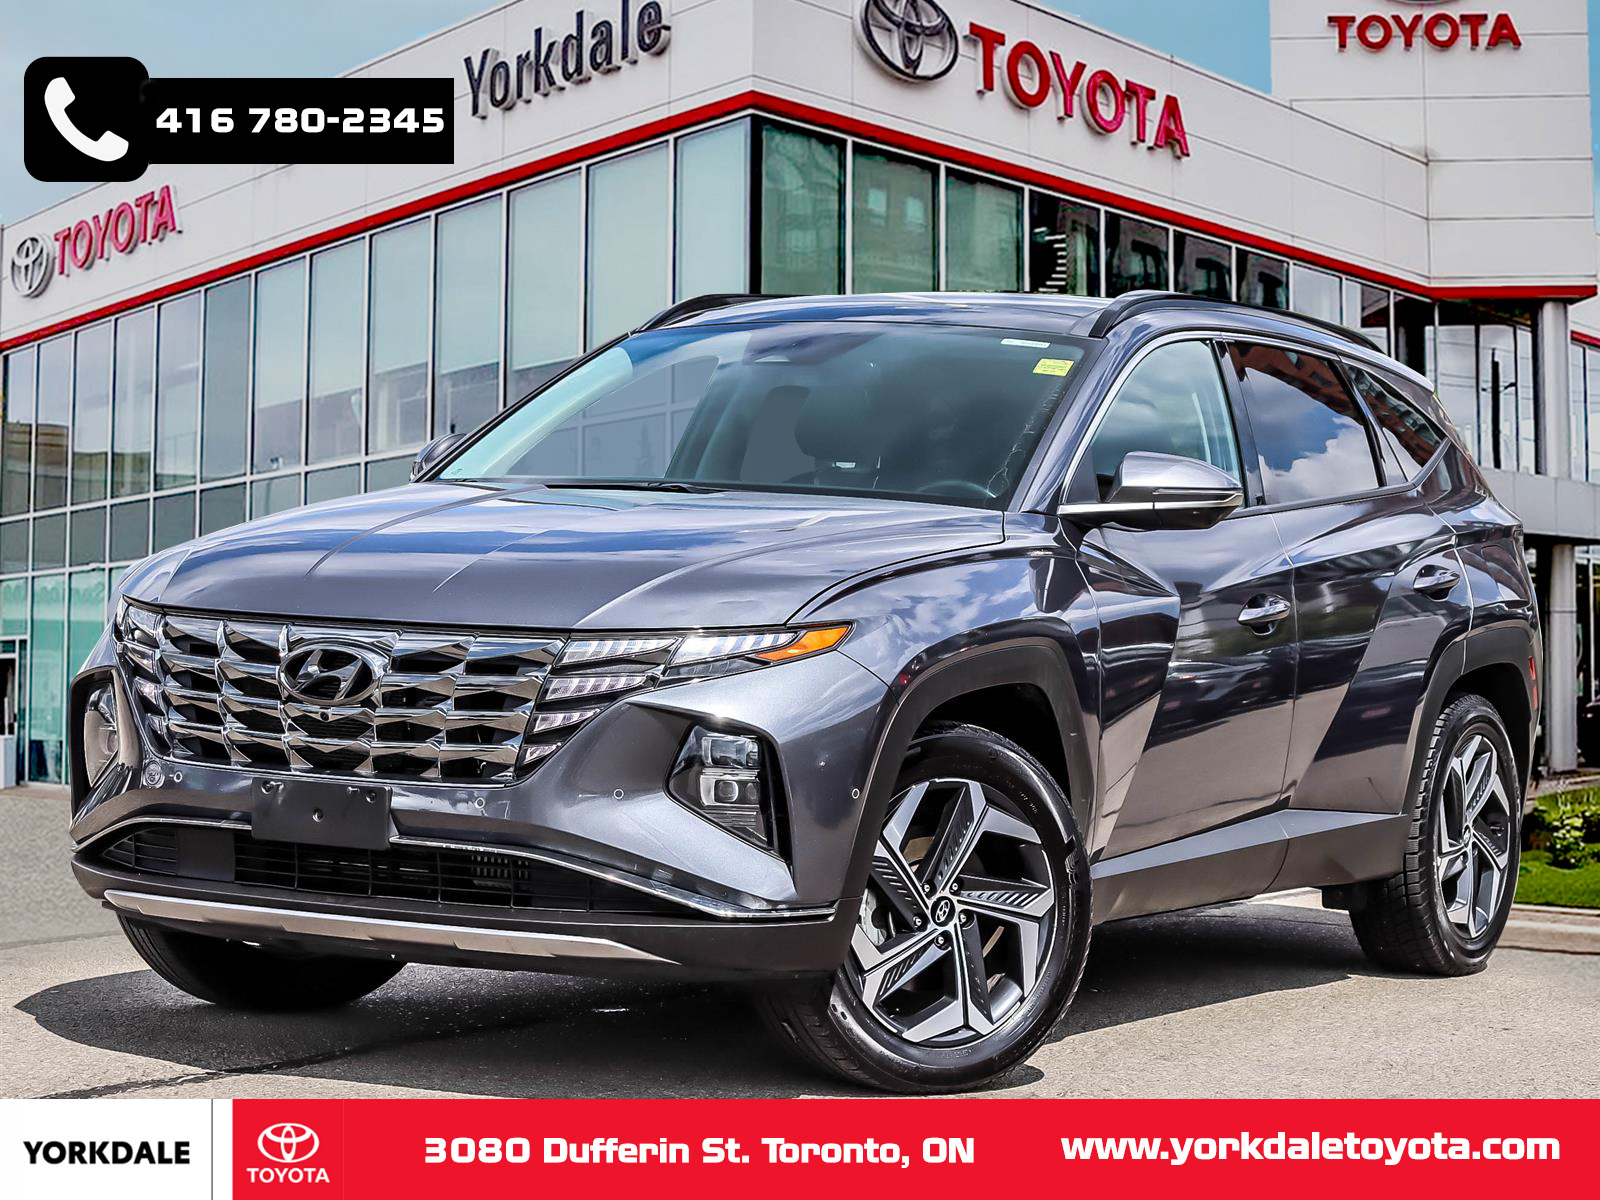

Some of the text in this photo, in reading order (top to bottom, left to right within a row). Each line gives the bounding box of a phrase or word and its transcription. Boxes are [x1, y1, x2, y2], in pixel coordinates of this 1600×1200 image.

[463, 0, 671, 119] Yorkdale
[1327, 13, 1522, 50] TOYOTA
[966, 21, 1191, 158] TOYOTA
[54, 184, 181, 276] TOYOTA
